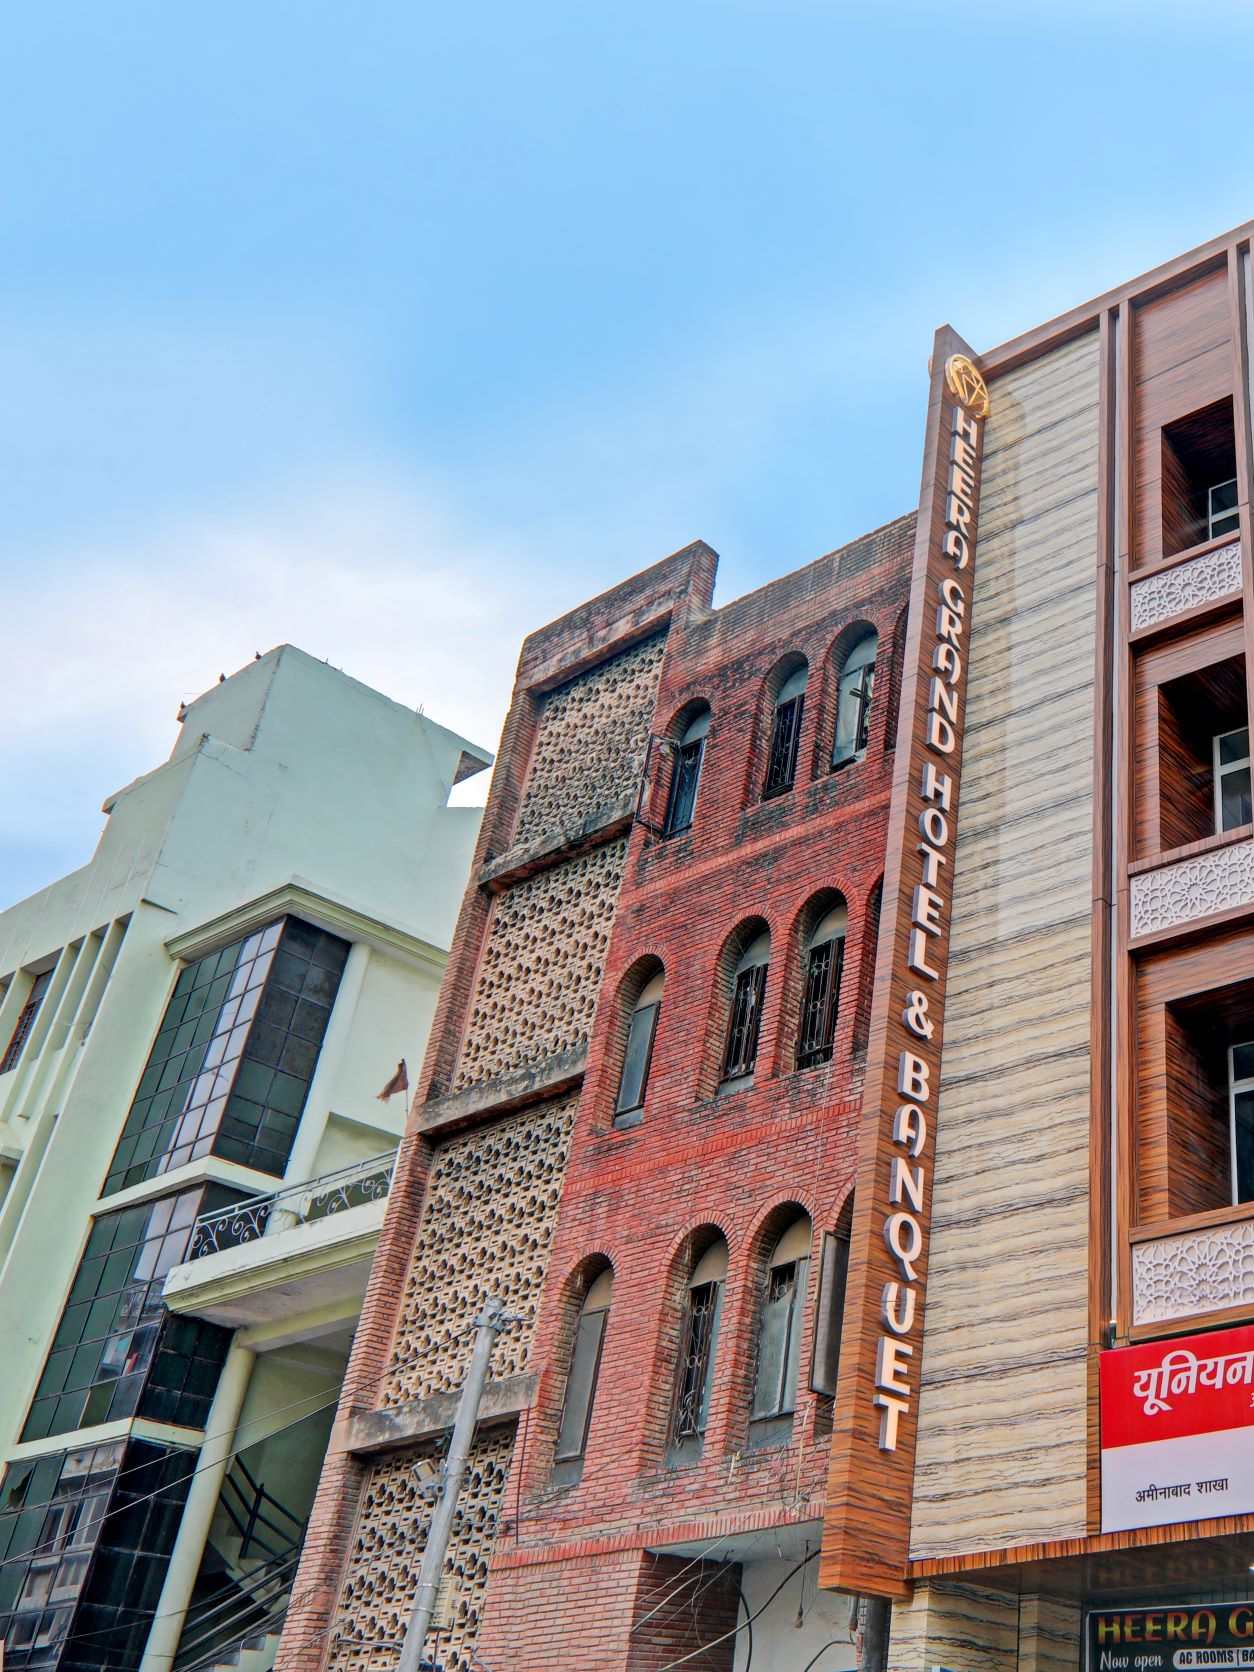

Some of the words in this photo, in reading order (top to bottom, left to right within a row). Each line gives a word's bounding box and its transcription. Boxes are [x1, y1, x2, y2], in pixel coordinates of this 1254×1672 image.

[943, 405, 978, 570] HEERA
[925, 578, 967, 754] GRAND
[908, 763, 953, 981] HOTEL
[902, 989, 935, 1041] &
[873, 1051, 930, 1452] BANQUET
[1135, 1482, 1191, 1502] अमीनाबाद
[1196, 1478, 1229, 1495] शाखा
[1098, 1610, 1216, 1645] HEERA
[1100, 1650, 1129, 1672] Now
[1134, 1655, 1163, 1672] open
[1179, 1652, 1193, 1665] AC
[1196, 1650, 1234, 1664] ROOMS
